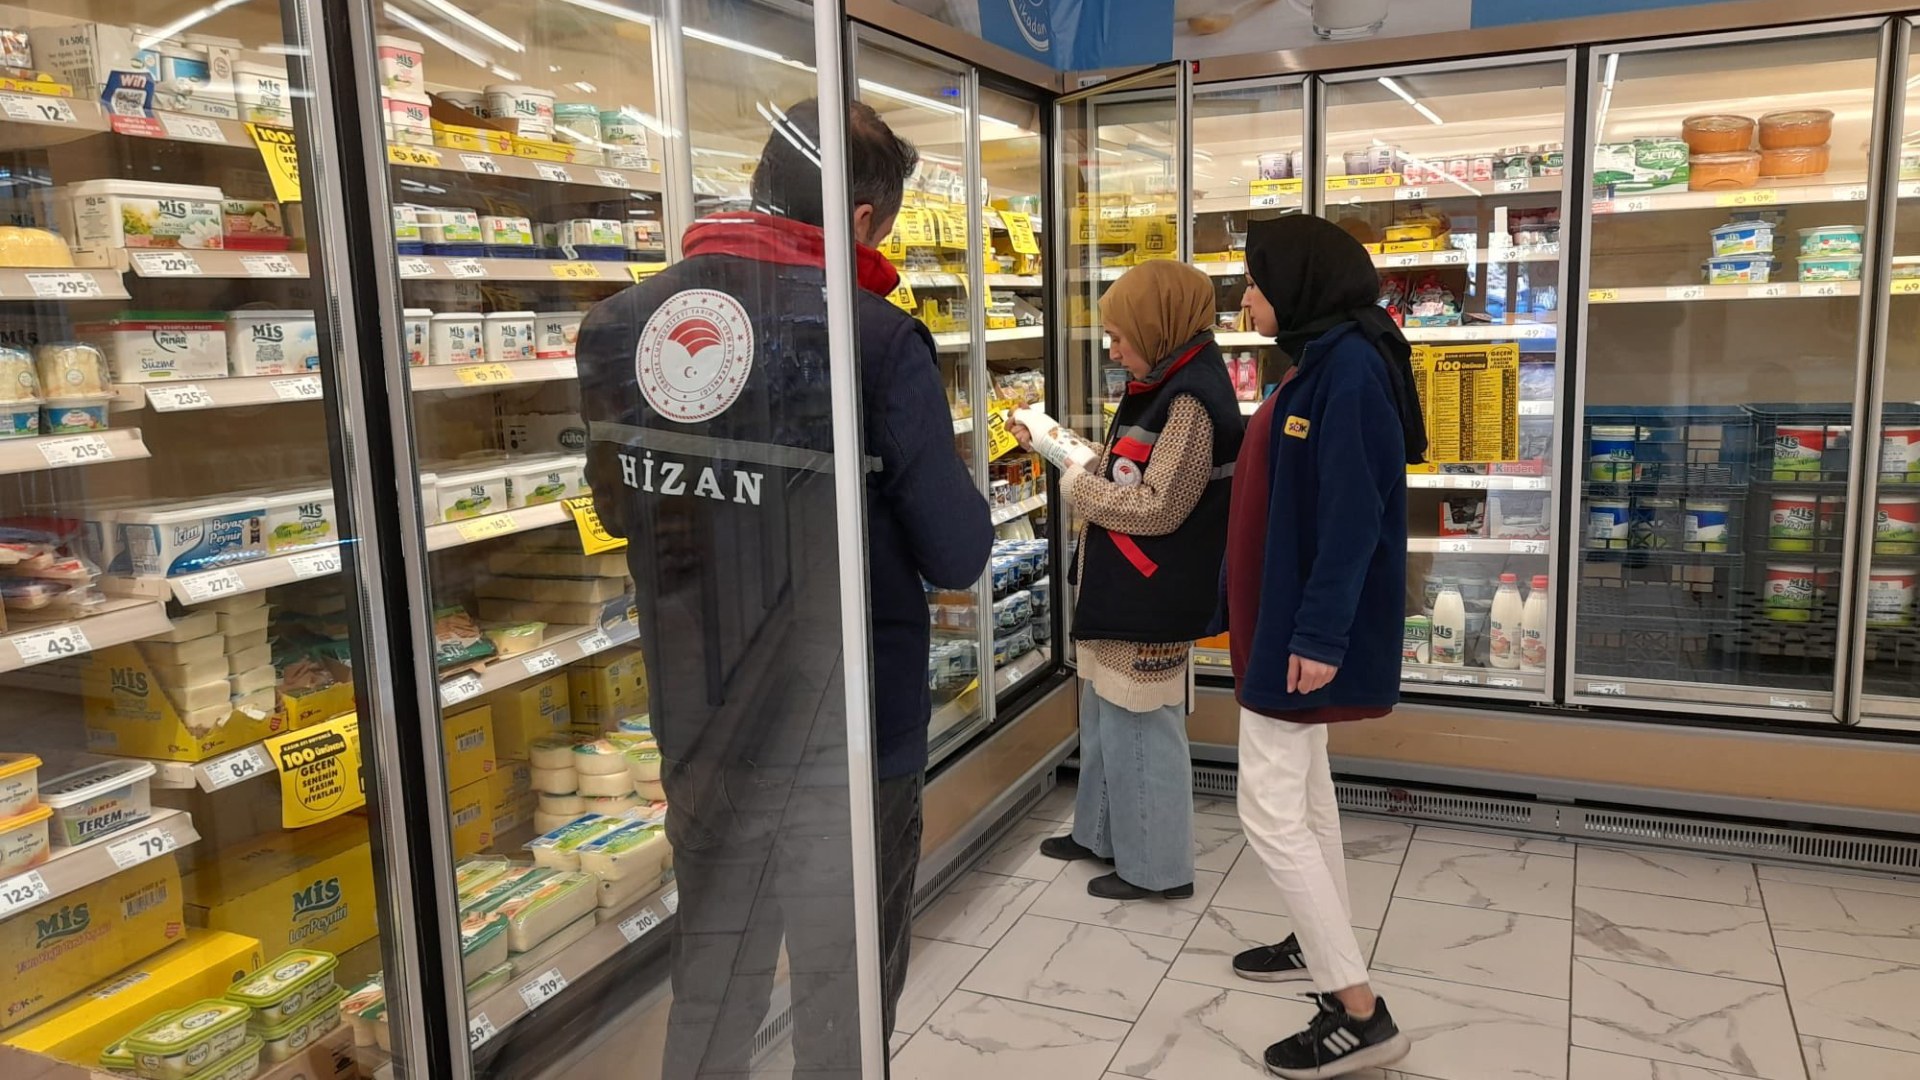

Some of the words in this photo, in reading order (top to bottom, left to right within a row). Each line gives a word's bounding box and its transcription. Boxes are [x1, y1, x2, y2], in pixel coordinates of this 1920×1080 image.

[1510, 183, 1522, 191] 57
[1407, 191, 1420, 199] 34
[159, 200, 186, 214] Mis
[1445, 255, 1459, 263] 30
[1503, 251, 1515, 259] 39
[161, 260, 187, 271] 229
[57, 281, 87, 294] 295
[252, 323, 284, 337] Mis
[1437, 361, 1461, 371] 100
[295, 384, 317, 396] 165
[174, 392, 201, 405] 235
[561, 433, 586, 445] rüta
[71, 443, 98, 459] 215
[617, 450, 764, 506] HİZAN
[298, 503, 322, 515] Mis
[212, 519, 245, 533] Beyaz
[208, 530, 242, 546] Peynir
[1453, 543, 1466, 552] 24
[1525, 545, 1538, 553] 37
[313, 560, 335, 573] 210
[208, 577, 232, 593] 272
[48, 636, 75, 654] 43
[110, 667, 148, 691] Mis
[282, 748, 315, 768] 100
[231, 759, 254, 778] 84
[300, 757, 336, 777] GEÇEN
[302, 769, 338, 788] SENENİN
[309, 779, 335, 794] KASIM
[304, 785, 342, 805] FİYATLARI
[77, 810, 122, 836] TEREM
[139, 837, 164, 857] 79
[3, 886, 34, 905] 123
[292, 876, 340, 913] Mis
[36, 903, 90, 940] Mis
[288, 923, 310, 945] Lor
[310, 903, 348, 935] Peyniri
[635, 916, 651, 931] 210
[539, 980, 558, 997] 219
